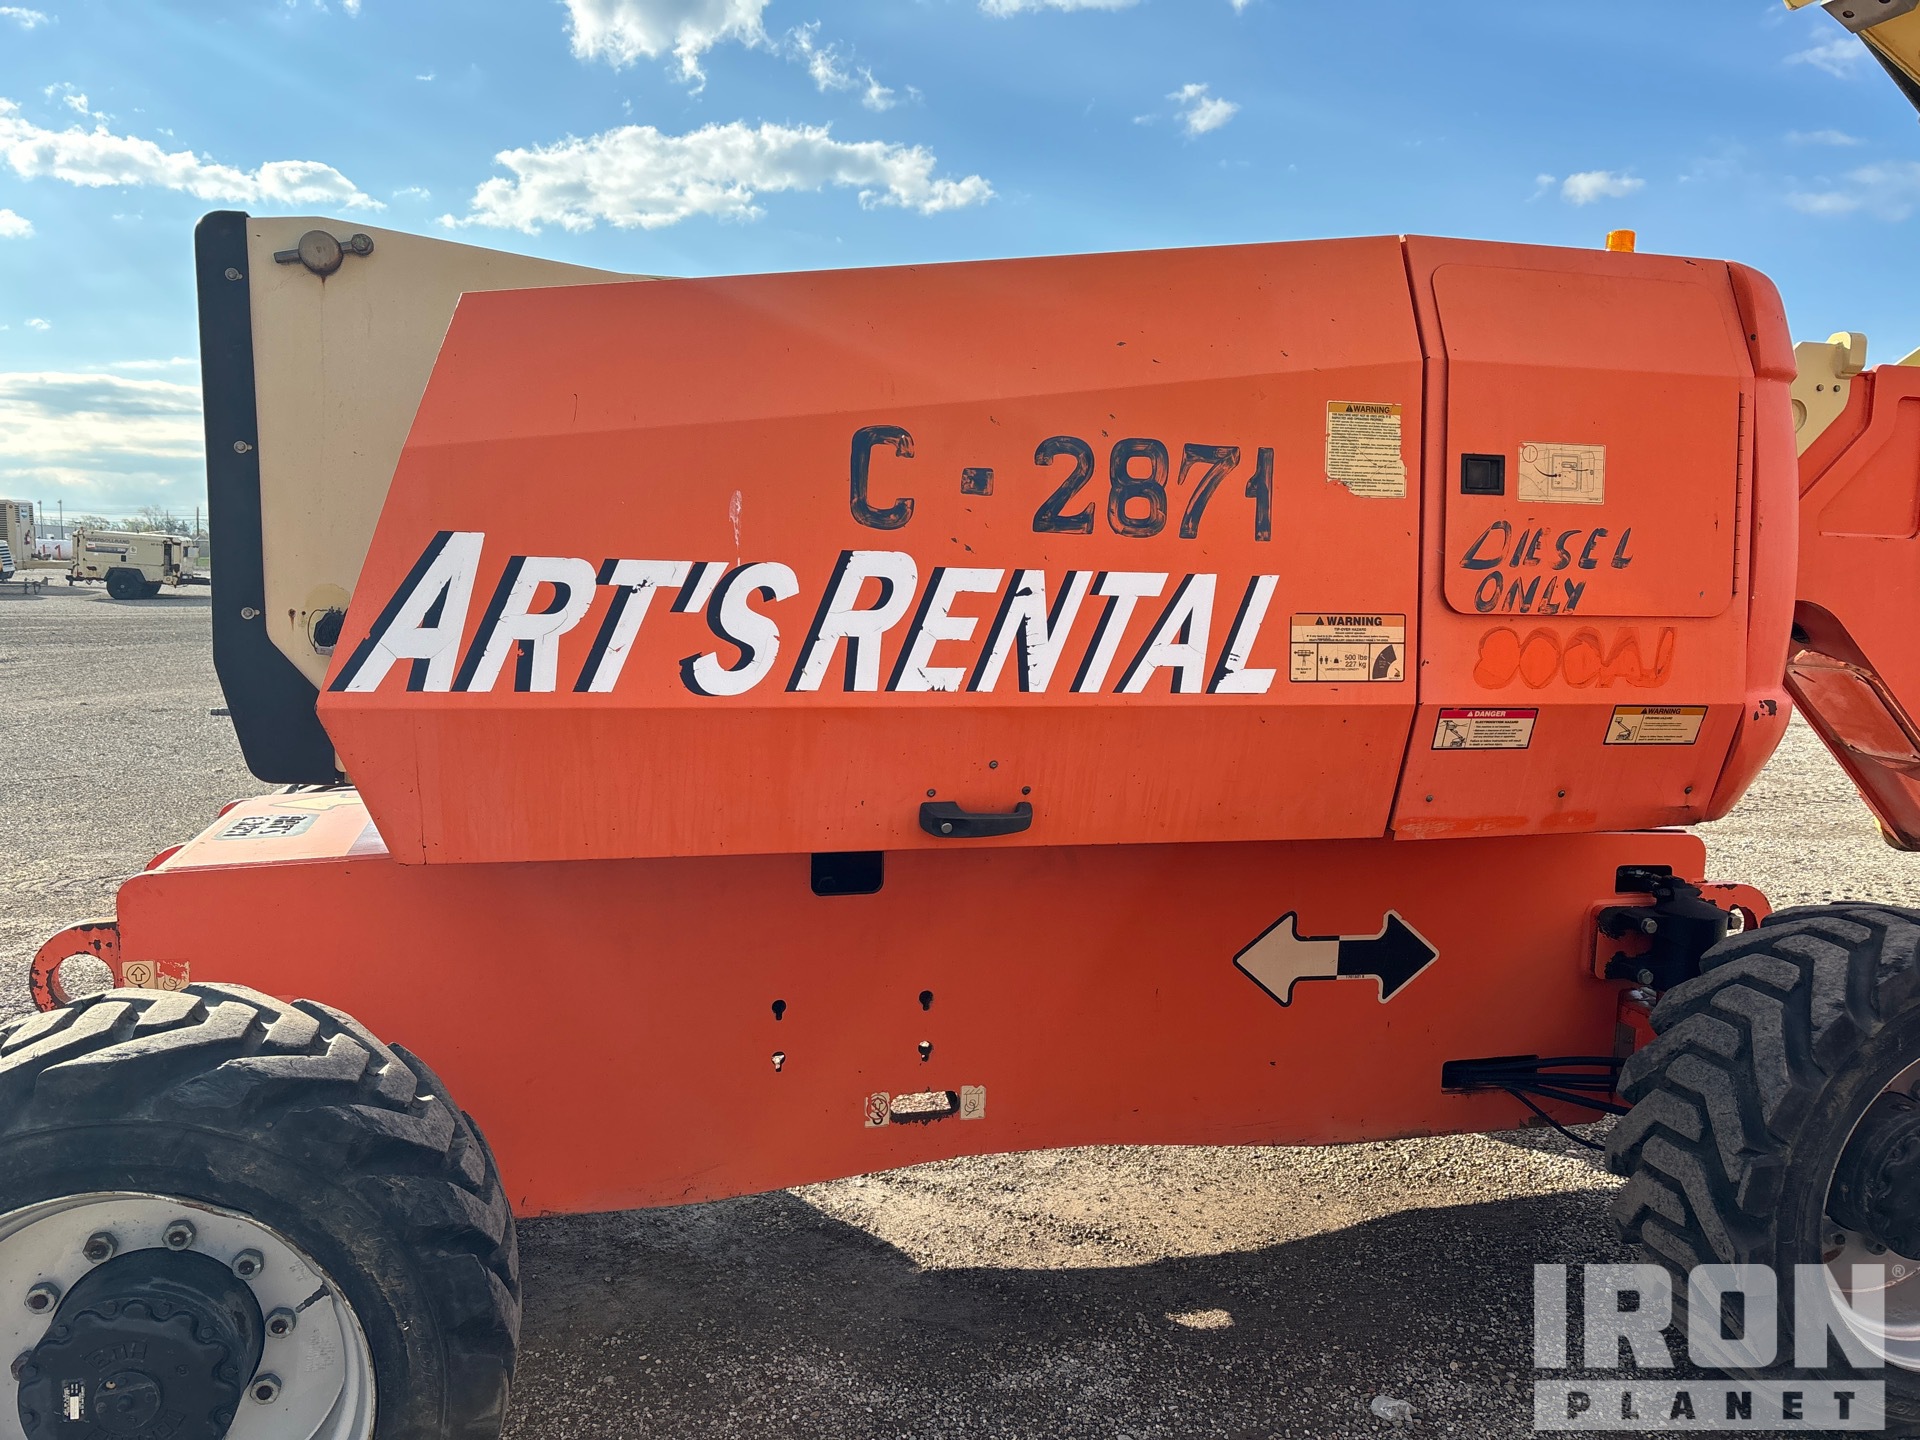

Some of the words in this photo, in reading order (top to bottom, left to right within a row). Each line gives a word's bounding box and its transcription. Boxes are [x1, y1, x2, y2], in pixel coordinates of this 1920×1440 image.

[1353, 405, 1390, 414] WARNING
[850, 425, 915, 530] C
[1032, 435, 1274, 541] 2871
[1459, 520, 1633, 571] DIESEL
[327, 530, 800, 696] ART'S
[785, 550, 1279, 693] RENTAL
[1474, 570, 1586, 615] ONLY
[1327, 616, 1382, 626] WARNING
[1358, 661, 1367, 669] kg
